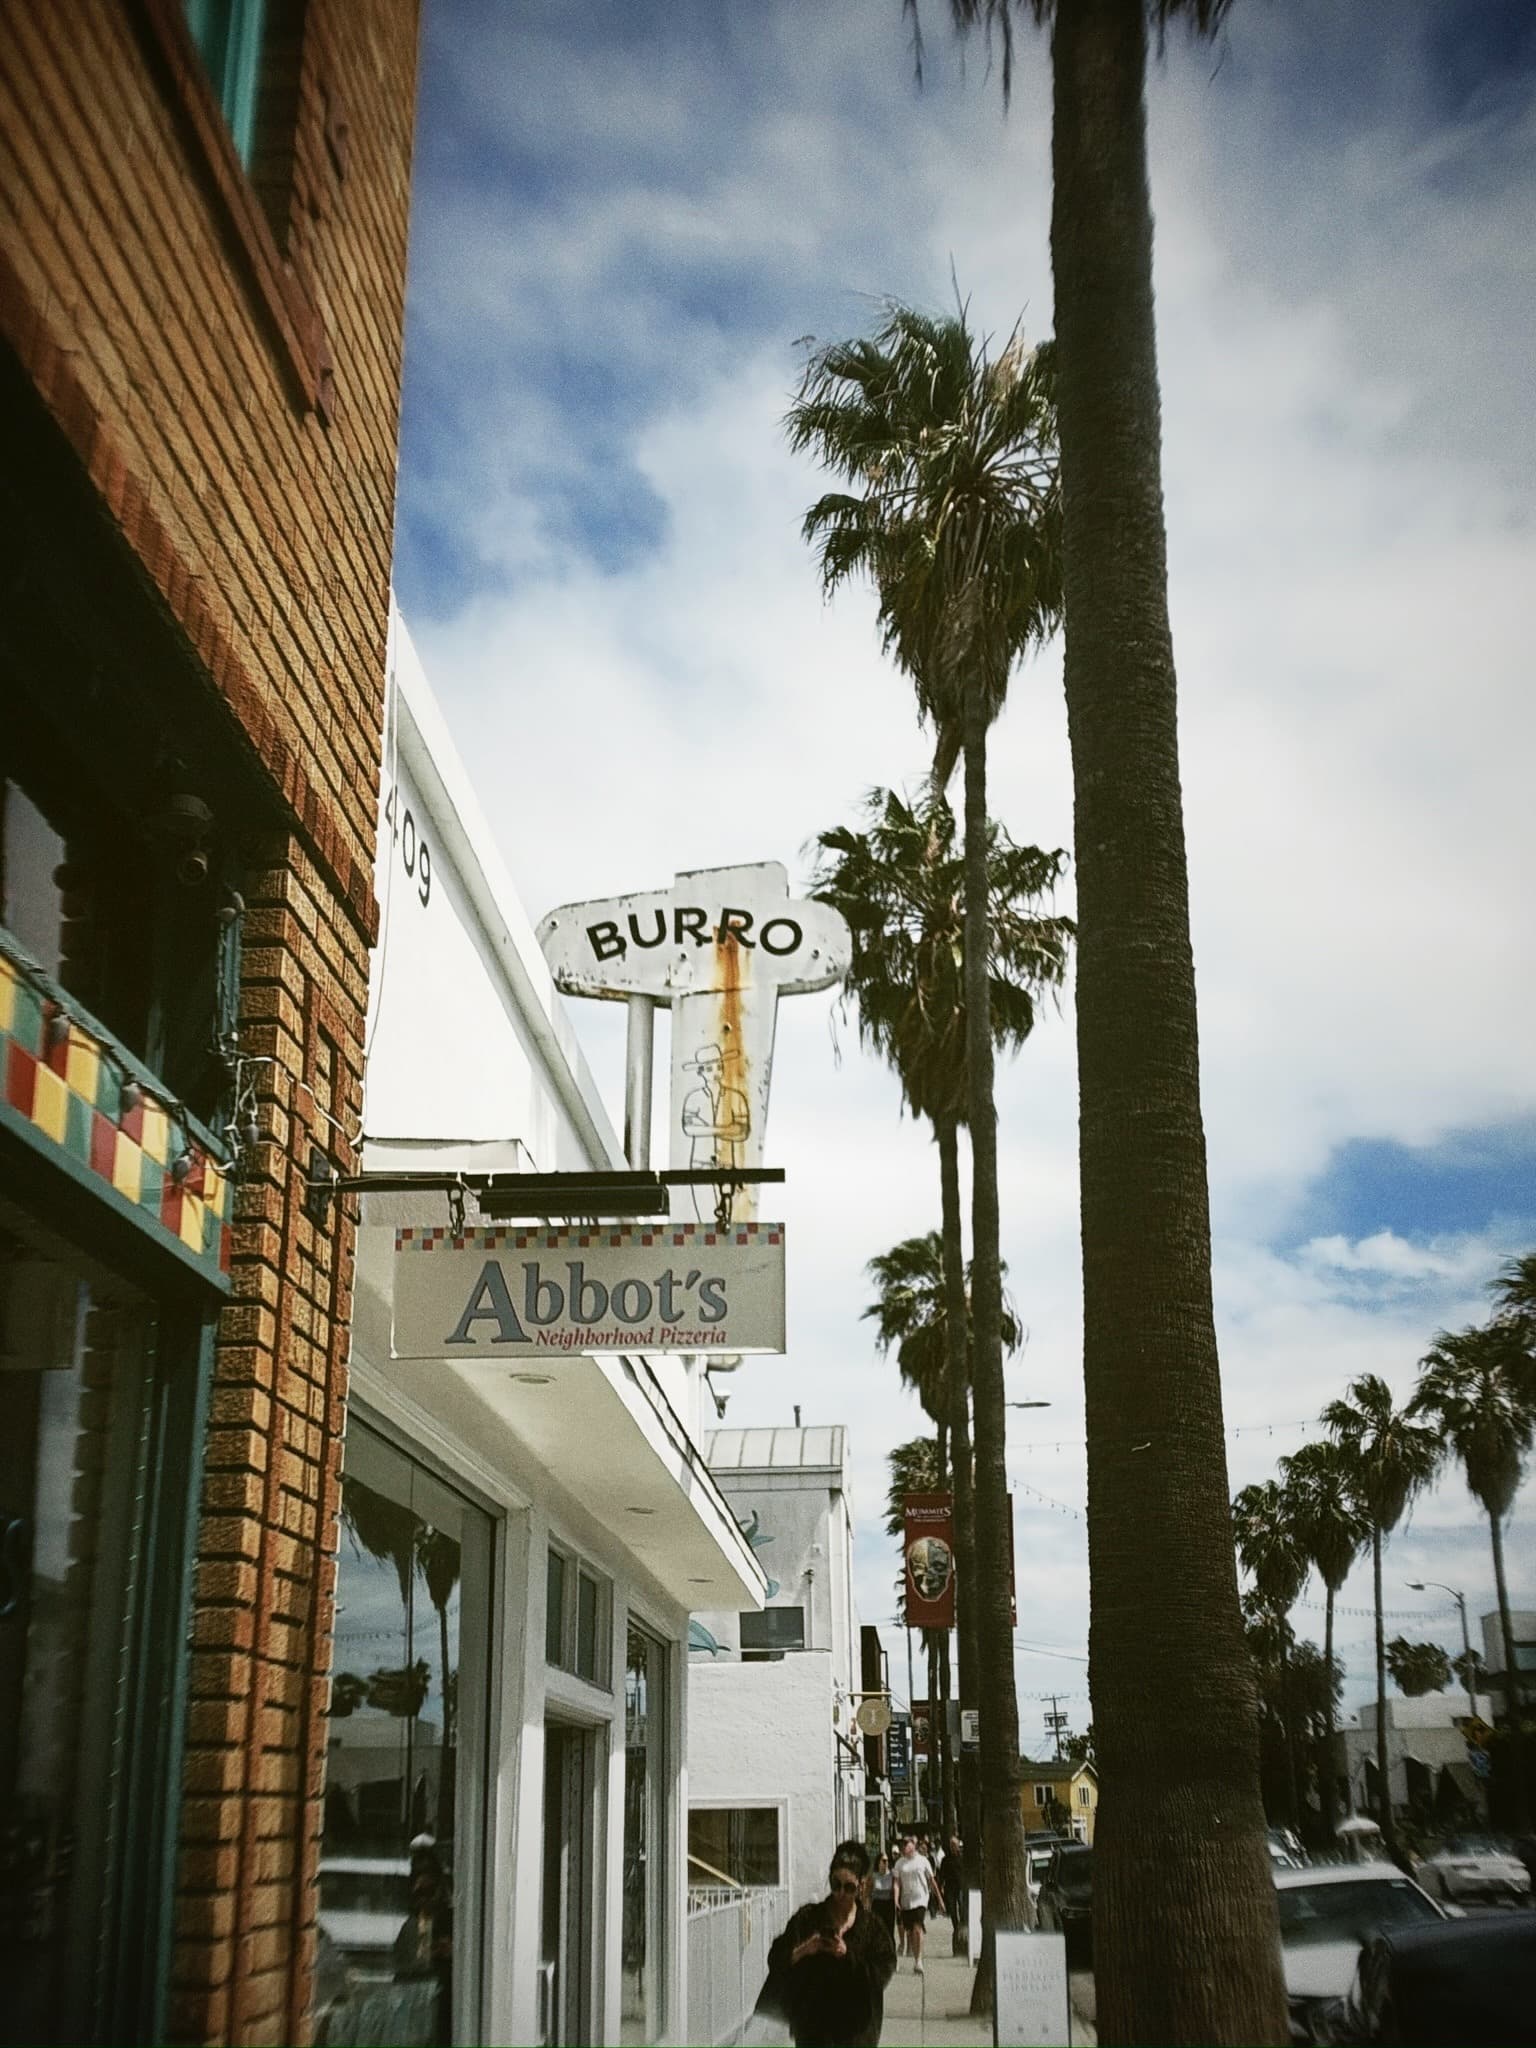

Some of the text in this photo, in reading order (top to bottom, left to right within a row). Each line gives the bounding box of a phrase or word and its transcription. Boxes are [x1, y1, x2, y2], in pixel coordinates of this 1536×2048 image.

[385, 784, 431, 908] 409
[586, 907, 803, 962] BURRO
[444, 1260, 728, 1344] Abbot's
[536, 1326, 727, 1350] Neighborhood Pizzeria
